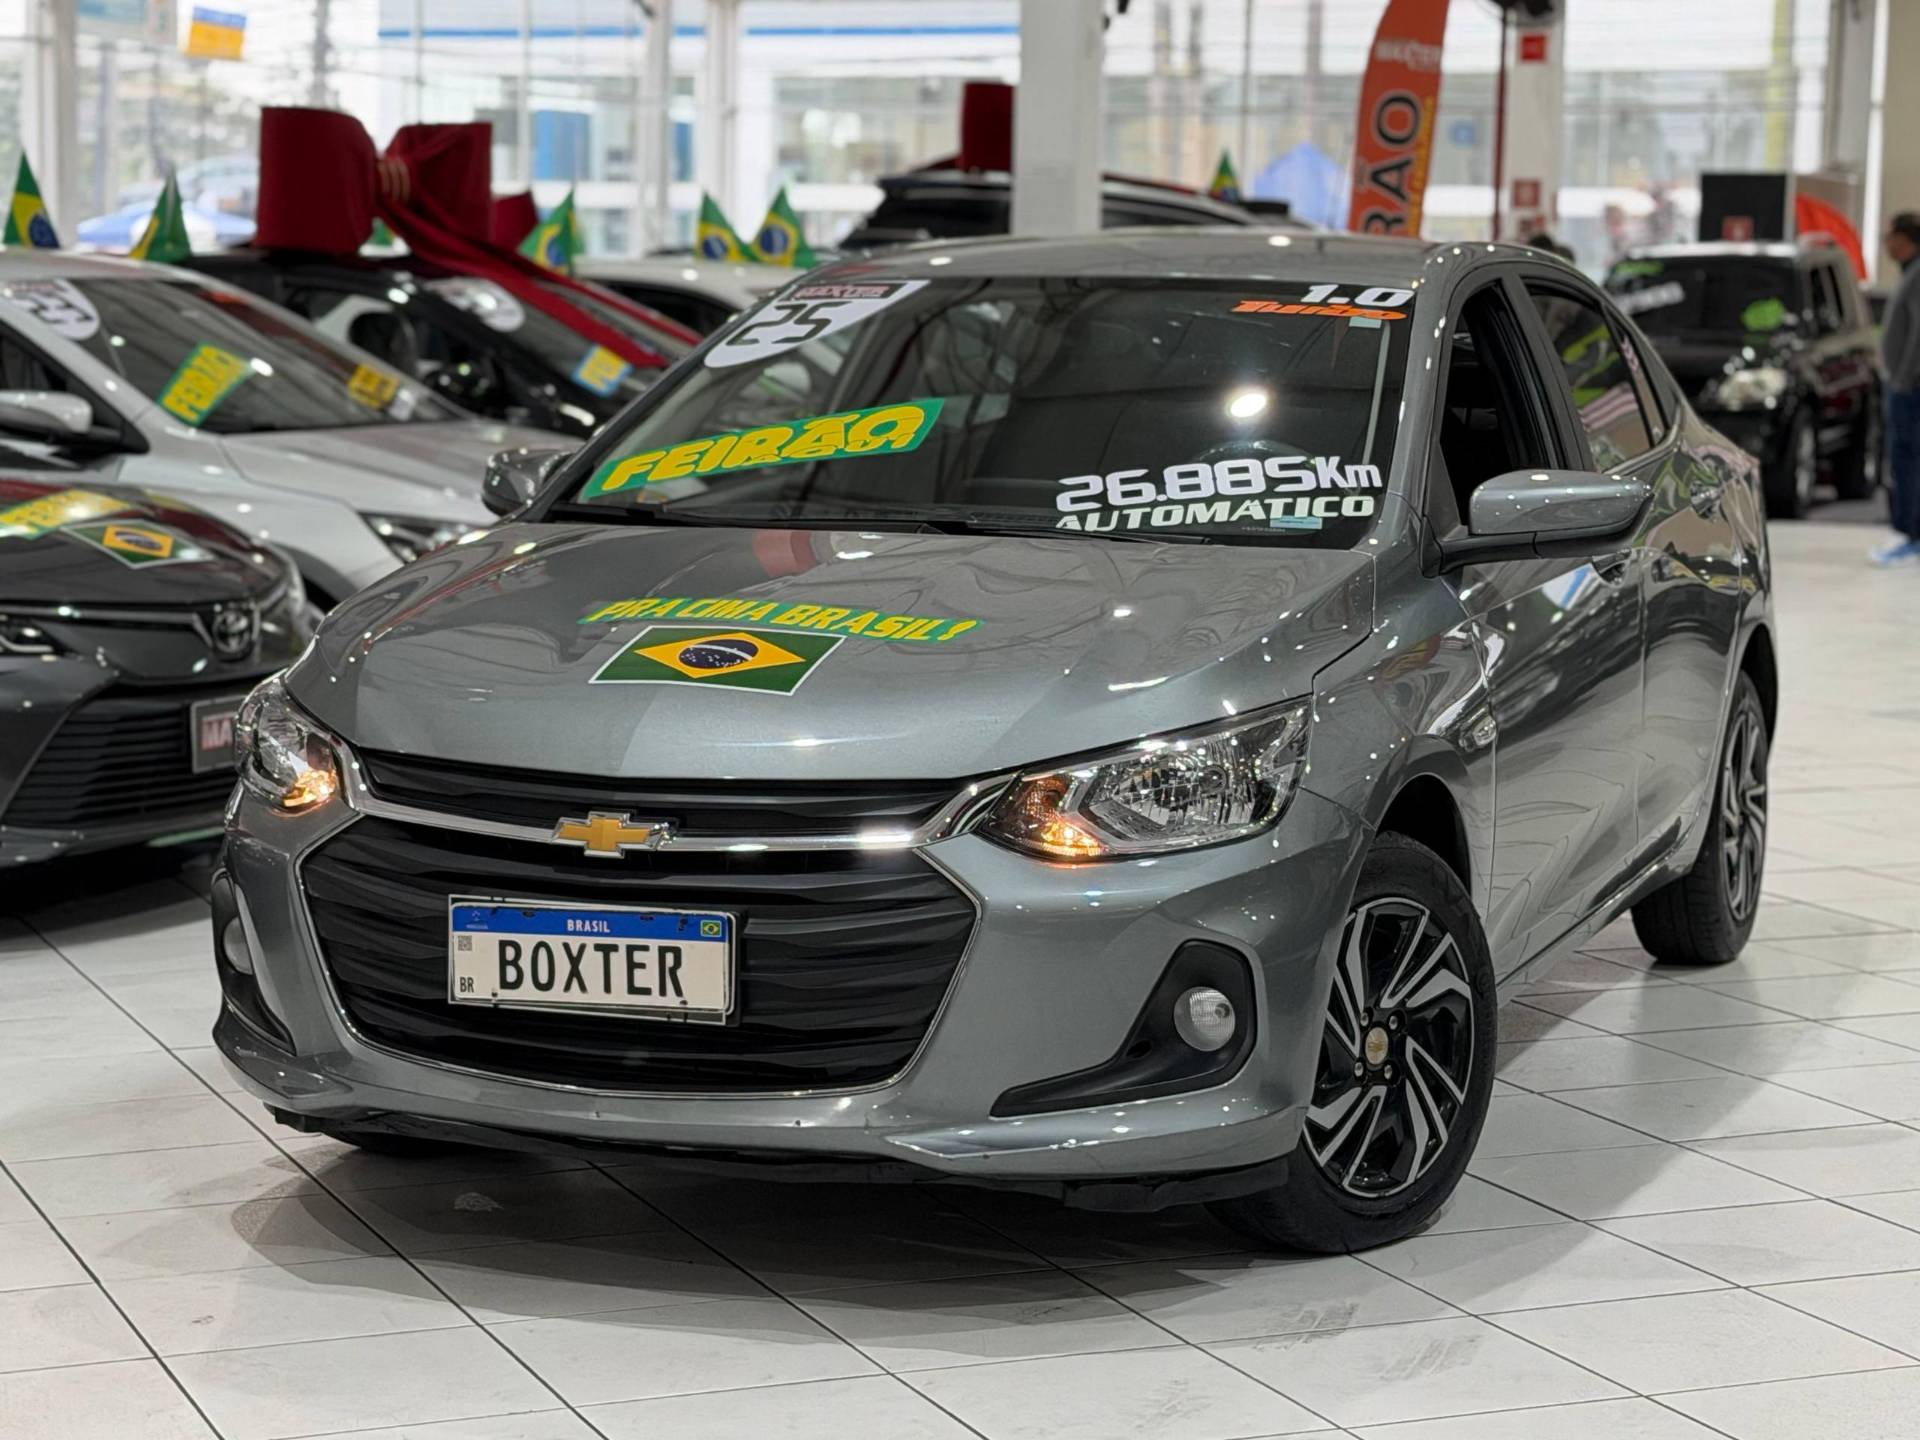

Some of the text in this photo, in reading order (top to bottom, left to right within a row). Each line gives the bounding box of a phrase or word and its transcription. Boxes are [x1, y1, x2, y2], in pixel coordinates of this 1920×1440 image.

[1301, 284, 1415, 307] 1.0
[725, 301, 853, 346] 25
[601, 405, 926, 491] FEIRÃO
[587, 598, 678, 622] PRA
[674, 599, 779, 621] CIMA
[567, 919, 611, 933] BRASIL
[498, 939, 684, 998] BOXTER
[459, 977, 475, 993] BR
